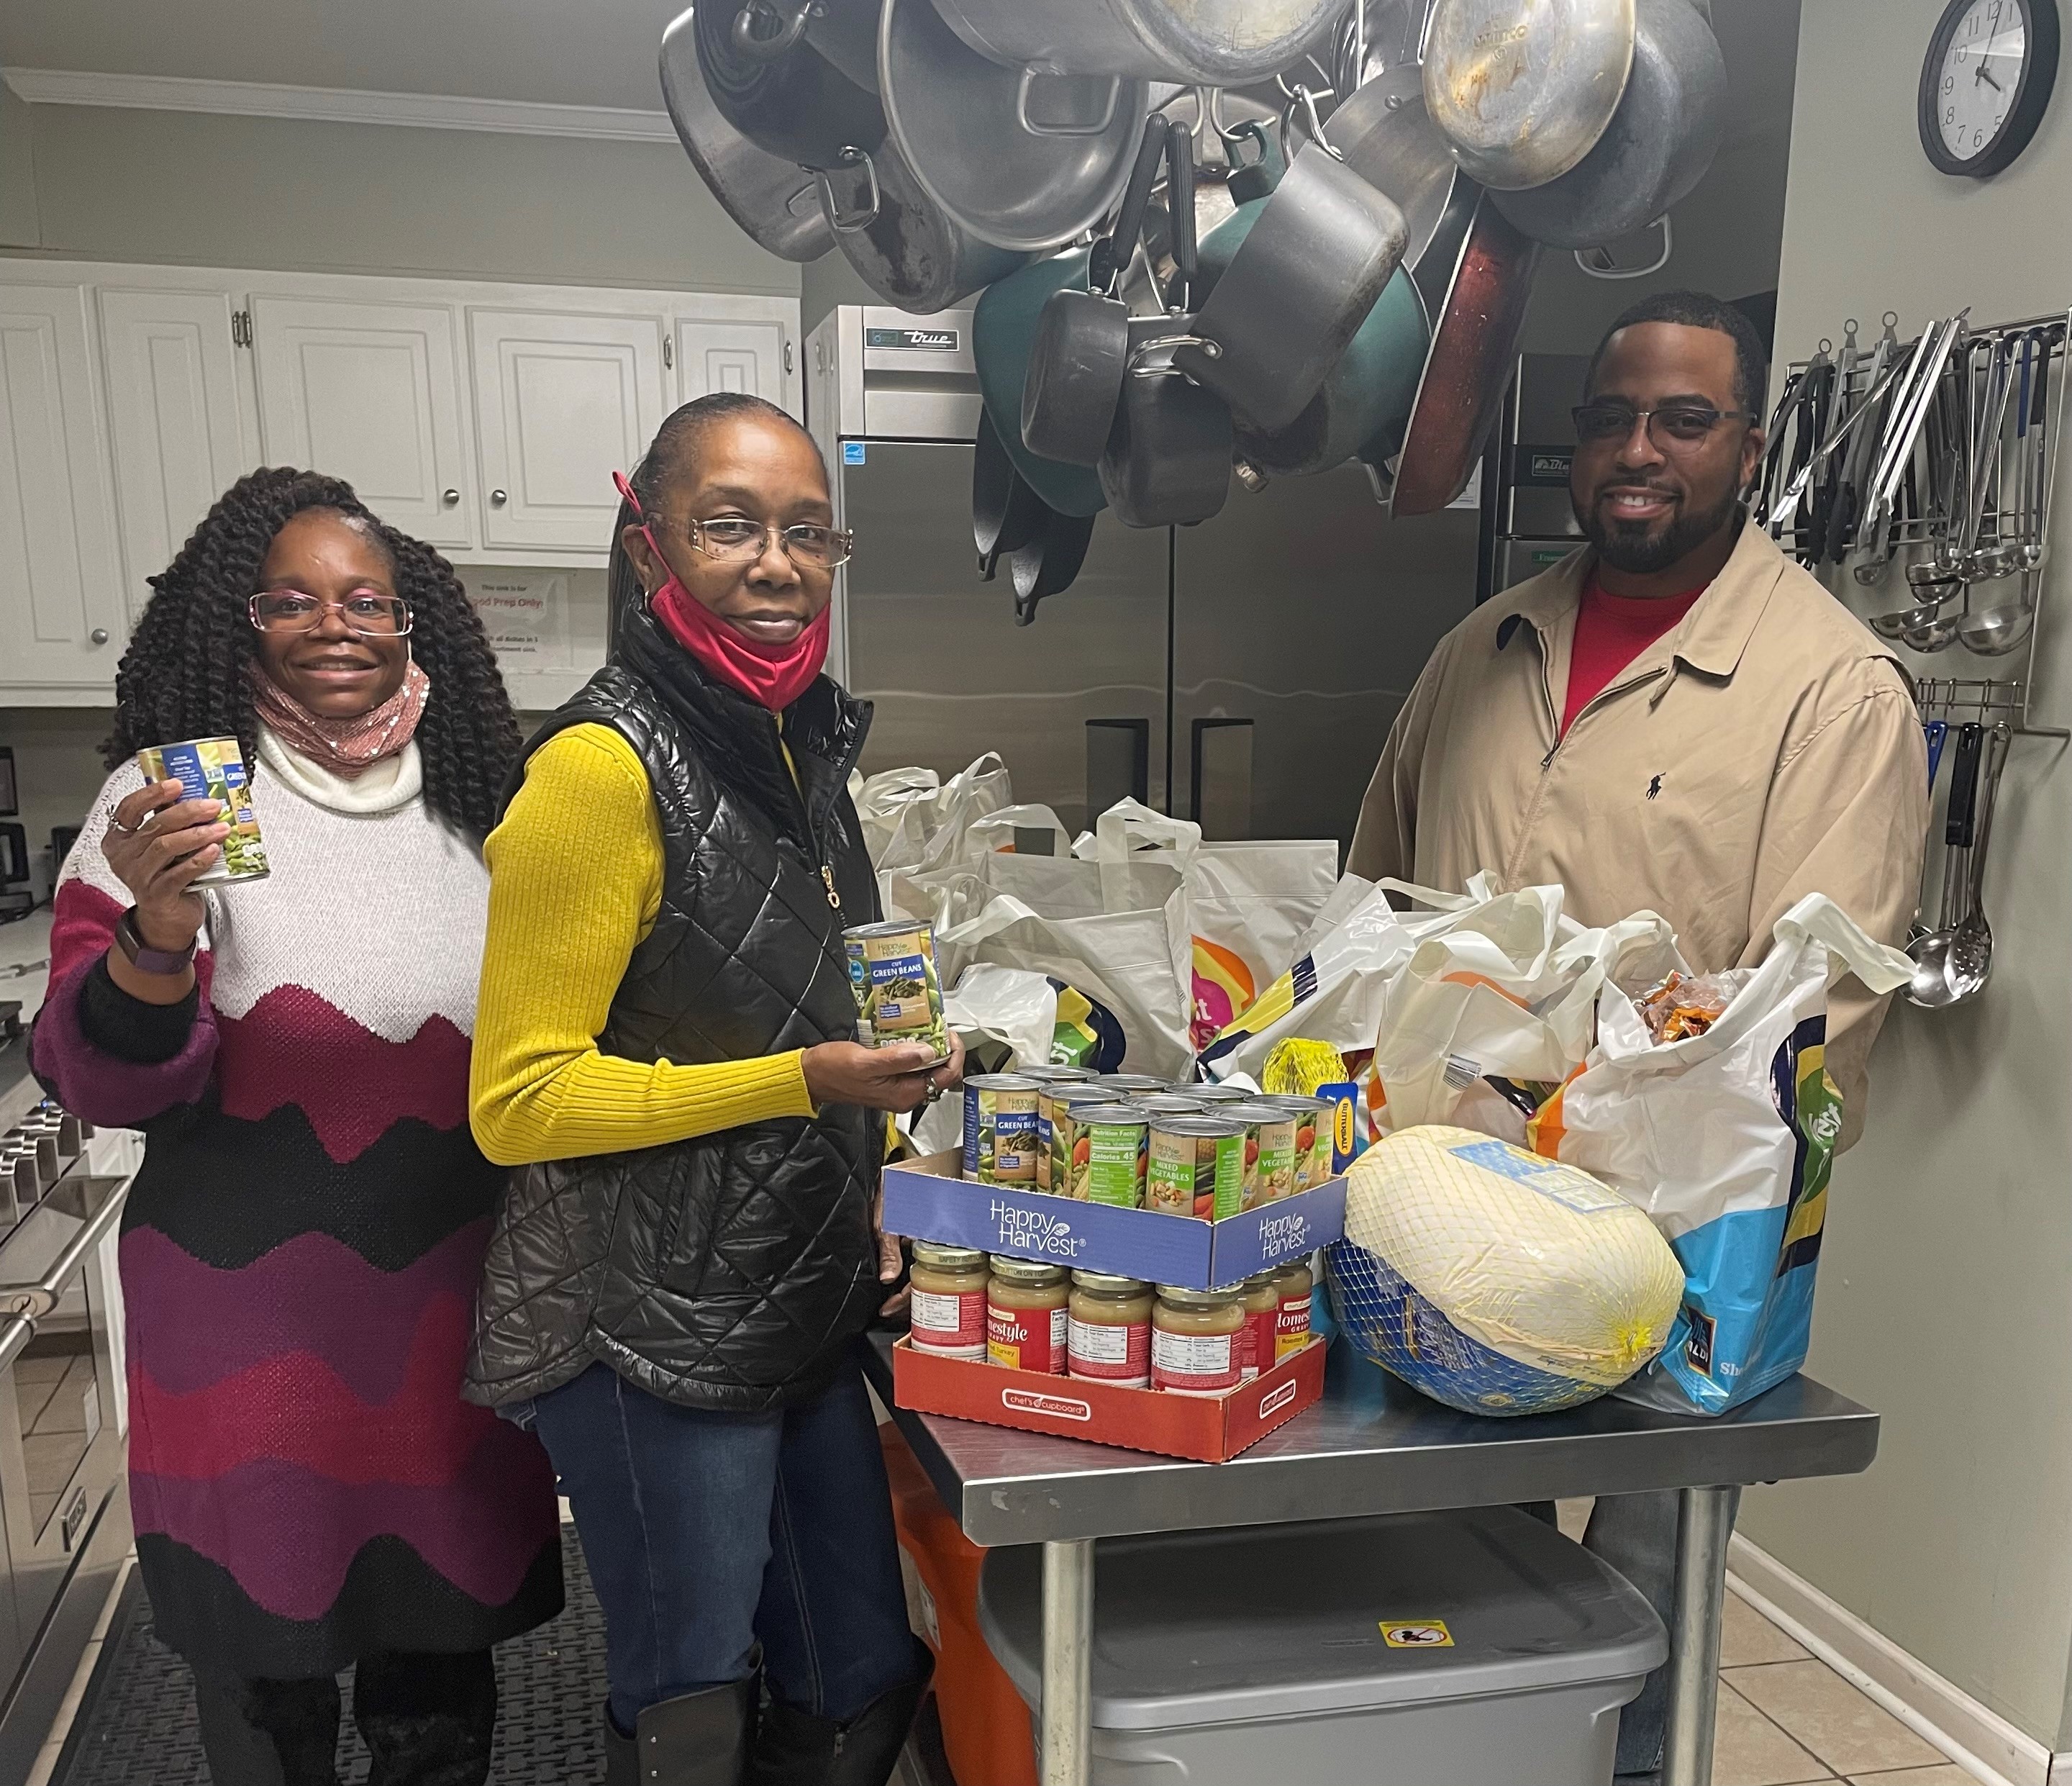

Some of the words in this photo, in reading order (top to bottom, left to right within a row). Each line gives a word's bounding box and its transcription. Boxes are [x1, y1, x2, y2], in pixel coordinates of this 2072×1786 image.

[1986, 0, 2000, 22] 12
[1968, 15, 1980, 36] 11
[1953, 44, 1968, 65] 10
[1945, 76, 1954, 96] 9
[1945, 106, 1955, 124] 8
[1957, 124, 1966, 144] 7
[1973, 129, 1983, 148] 6
[873, 967, 898, 978] GREEN
[899, 964, 922, 975] BEANS
[998, 1121, 1022, 1130] GREEN
[1091, 1152, 1120, 1161] Calories
[1122, 1152, 1135, 1161] 45
[1273, 1149, 1292, 1159] MIXED
[1156, 1161, 1178, 1171] MIXED
[989, 1199, 1056, 1235] Happy
[1258, 1212, 1297, 1241] Happy
[988, 1320, 1028, 1343] mestyle
[996, 1346, 1016, 1358] Turkey
[1687, 1341, 1709, 1363] ALDI
[1009, 1395, 1034, 1407] chef's
